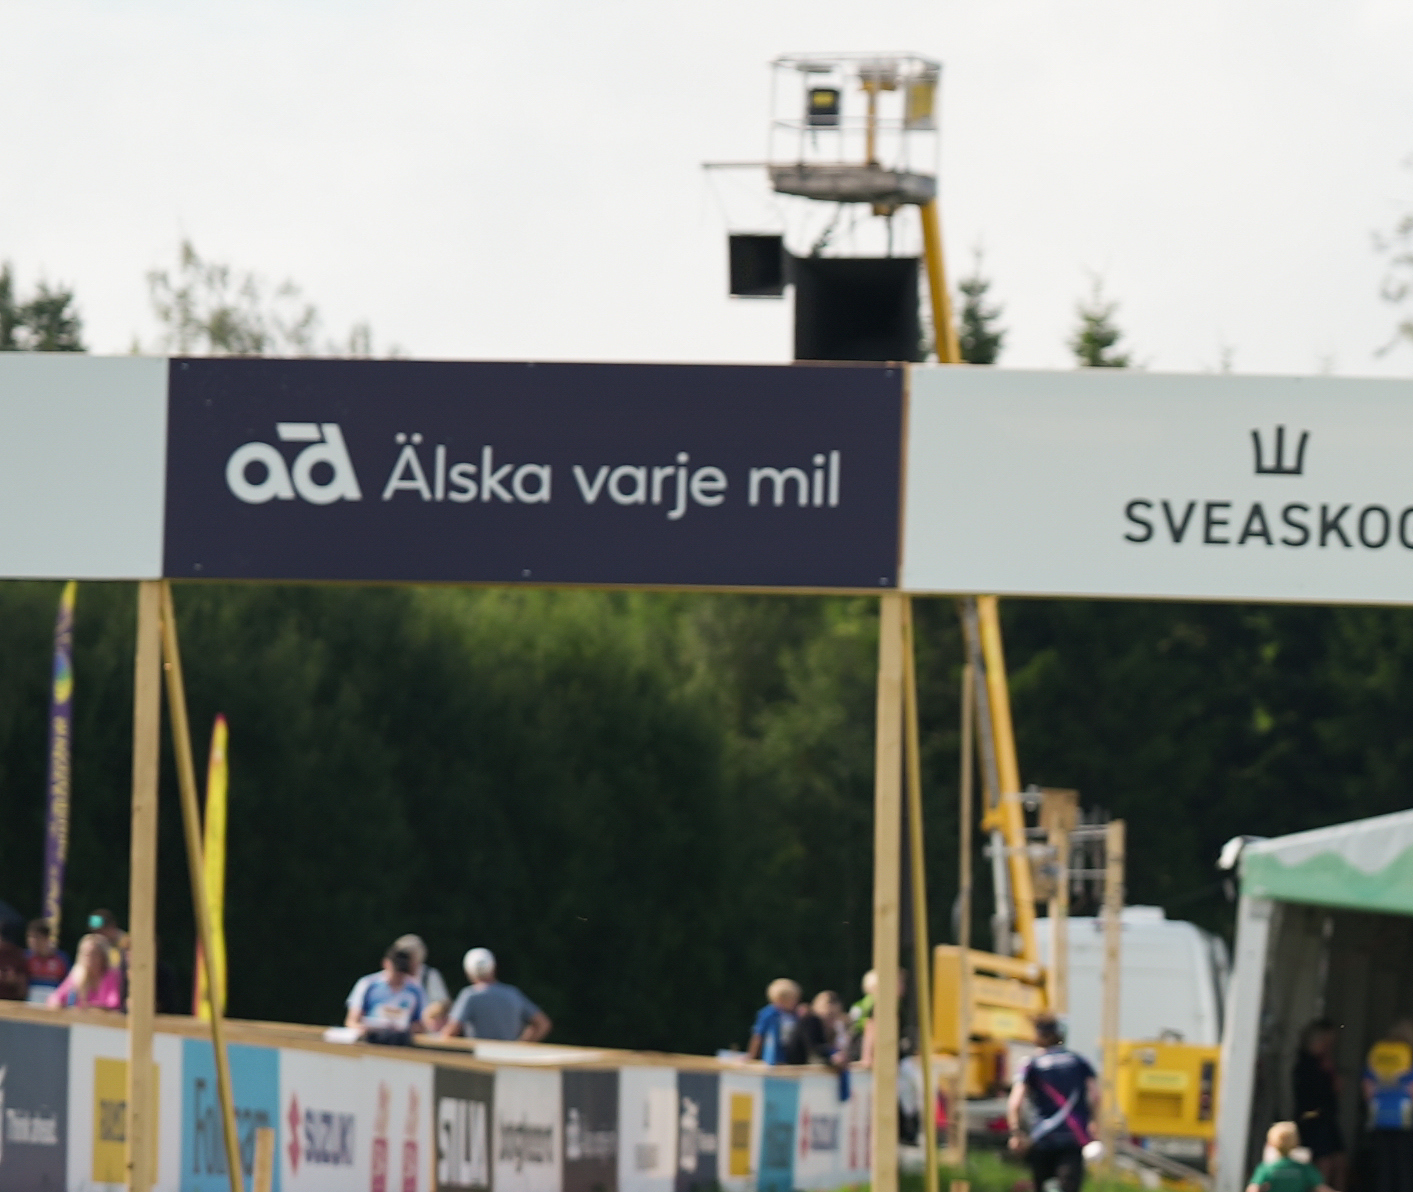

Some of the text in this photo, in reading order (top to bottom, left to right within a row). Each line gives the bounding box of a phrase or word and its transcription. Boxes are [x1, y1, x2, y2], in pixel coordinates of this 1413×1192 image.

[382, 432, 552, 503] Älska
[573, 452, 728, 520] varje
[749, 450, 841, 507] mil
